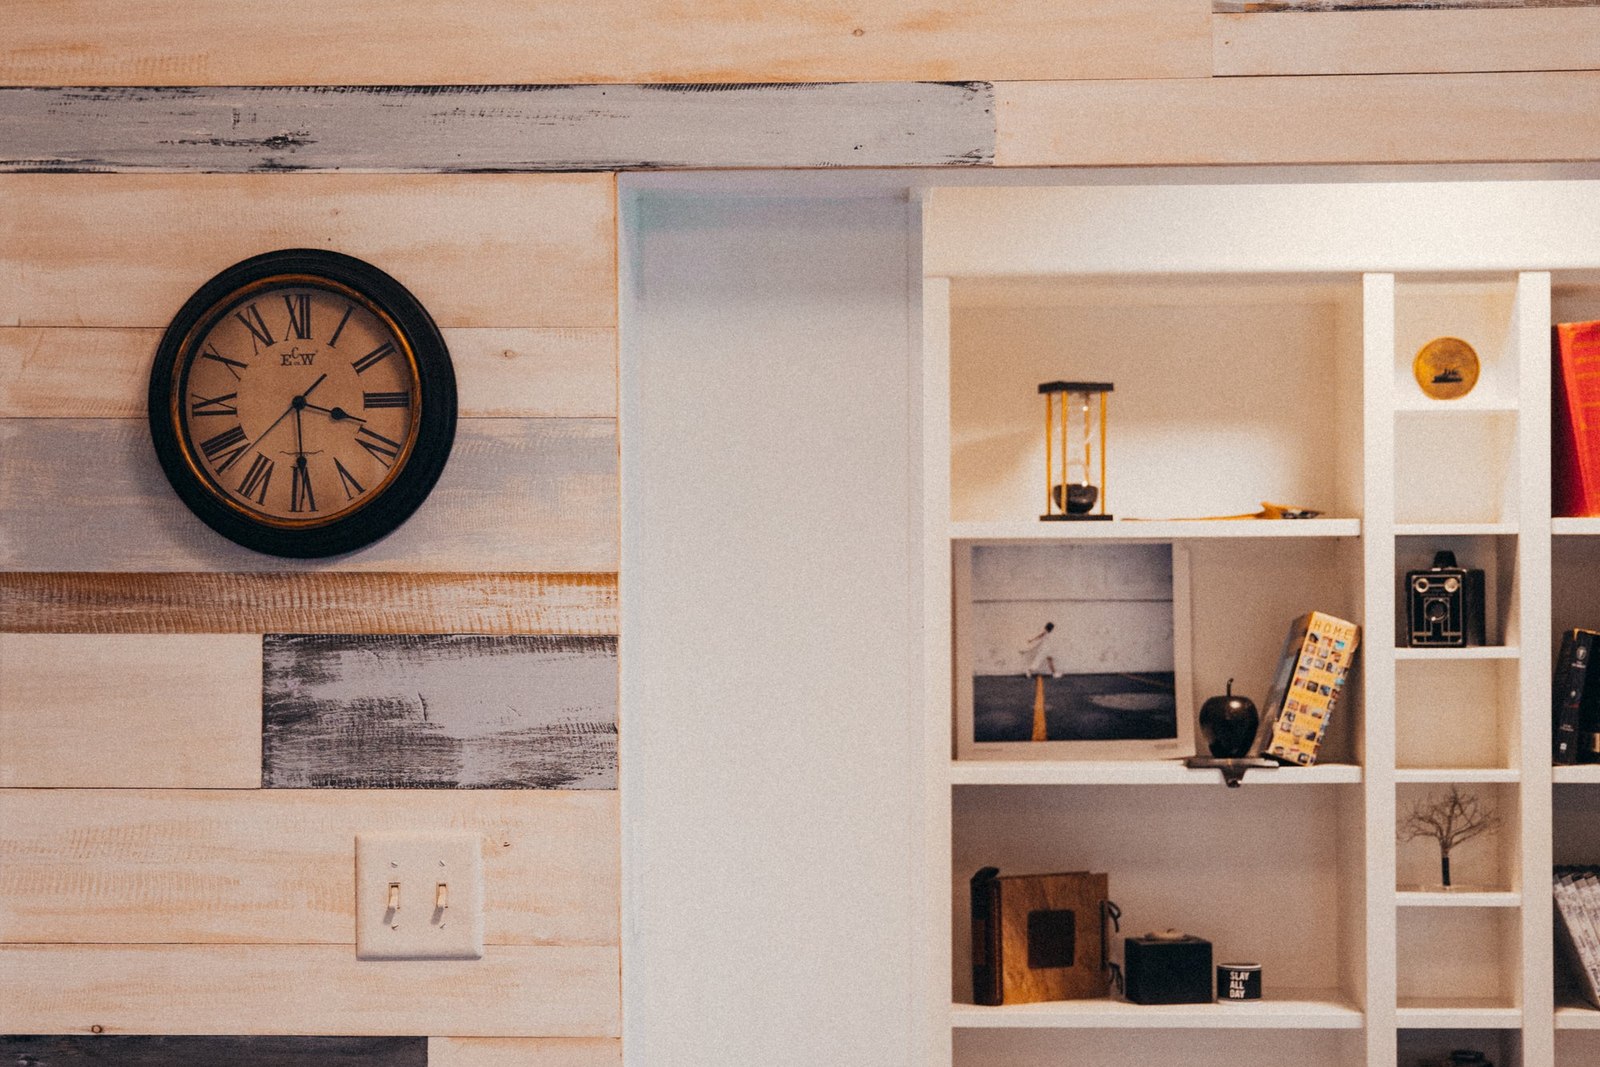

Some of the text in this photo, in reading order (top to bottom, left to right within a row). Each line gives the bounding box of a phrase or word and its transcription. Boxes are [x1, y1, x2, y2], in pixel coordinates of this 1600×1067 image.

[1314, 621, 1353, 640] HOME
[1230, 971, 1250, 980] SLAY
[1230, 980, 1245, 989] ALL
[1229, 989, 1246, 998] DAY
